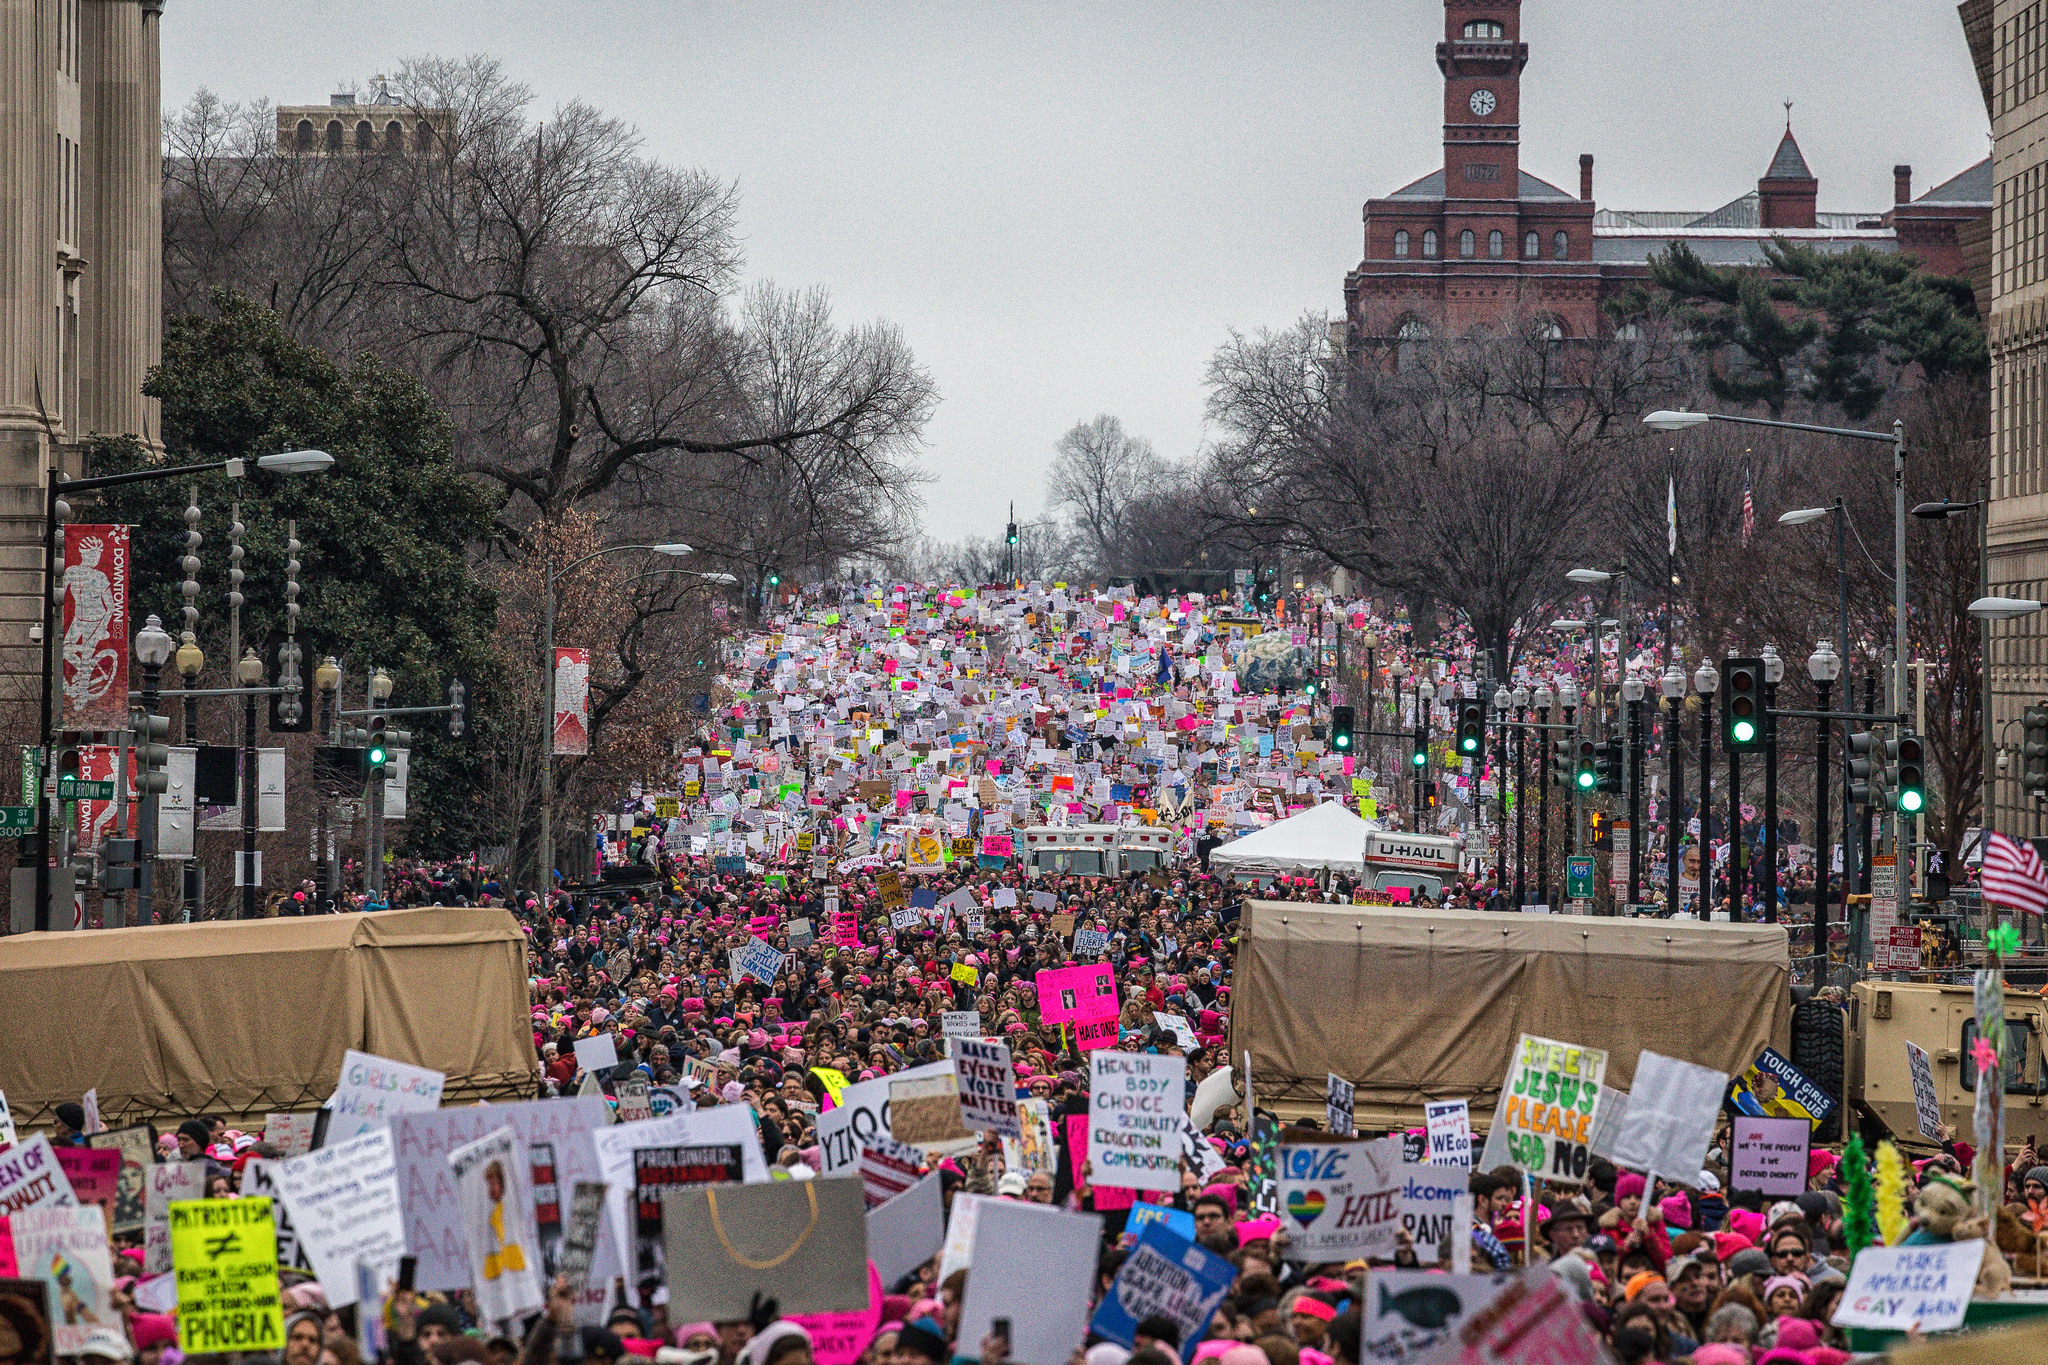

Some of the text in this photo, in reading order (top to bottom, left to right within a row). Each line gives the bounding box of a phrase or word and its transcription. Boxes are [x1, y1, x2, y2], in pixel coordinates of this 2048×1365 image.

[60, 782, 73, 794] RON
[76, 783, 100, 797] BROWN
[17, 817, 28, 825] NW
[1380, 844, 1445, 860] U-HAUL
[879, 876, 897, 887] STOP
[1574, 867, 1587, 875] 495
[882, 890, 903, 903] LYING
[1079, 938, 1105, 946] FUERTE
[1081, 931, 1104, 940] FIERCE
[1076, 946, 1103, 954] FEMME
[1079, 1021, 1117, 1041] HAVE ONE
[961, 1041, 1000, 1062] MAKE
[1521, 1038, 1604, 1079] SWEET
[349, 1063, 398, 1092] GIRLS
[959, 1059, 1007, 1082] EVERY
[1097, 1058, 1151, 1076] HEALTH
[966, 1077, 1005, 1098] VOTE
[1126, 1077, 1170, 1092] BODY
[1763, 1051, 1831, 1110] TOUGH GIRLS
[1514, 1068, 1598, 1115] JESUS
[960, 1091, 1016, 1117] MATTER
[1097, 1092, 1164, 1113] CHOICE
[1793, 1089, 1823, 1119] CLUB
[1118, 1114, 1181, 1133] SEXUALITY
[1505, 1095, 1592, 1145] PLEASE
[1094, 1128, 1161, 1149] EDUCATION
[1432, 1134, 1468, 1152] WE GO
[24, 1146, 43, 1170] OF
[1102, 1151, 1178, 1171] COMPENSATION
[1280, 1148, 1349, 1180] LOVE
[1507, 1130, 1587, 1179] GOD NO
[1739, 1169, 1798, 1179] DEFEND DIGNITY
[1336, 1187, 1402, 1228] HATE
[1895, 1250, 1948, 1271] MAKE
[1861, 1273, 1948, 1292] AMERICA
[1853, 1296, 1960, 1318] GAY AGAIN
[186, 1313, 278, 1346] PHOBIA
